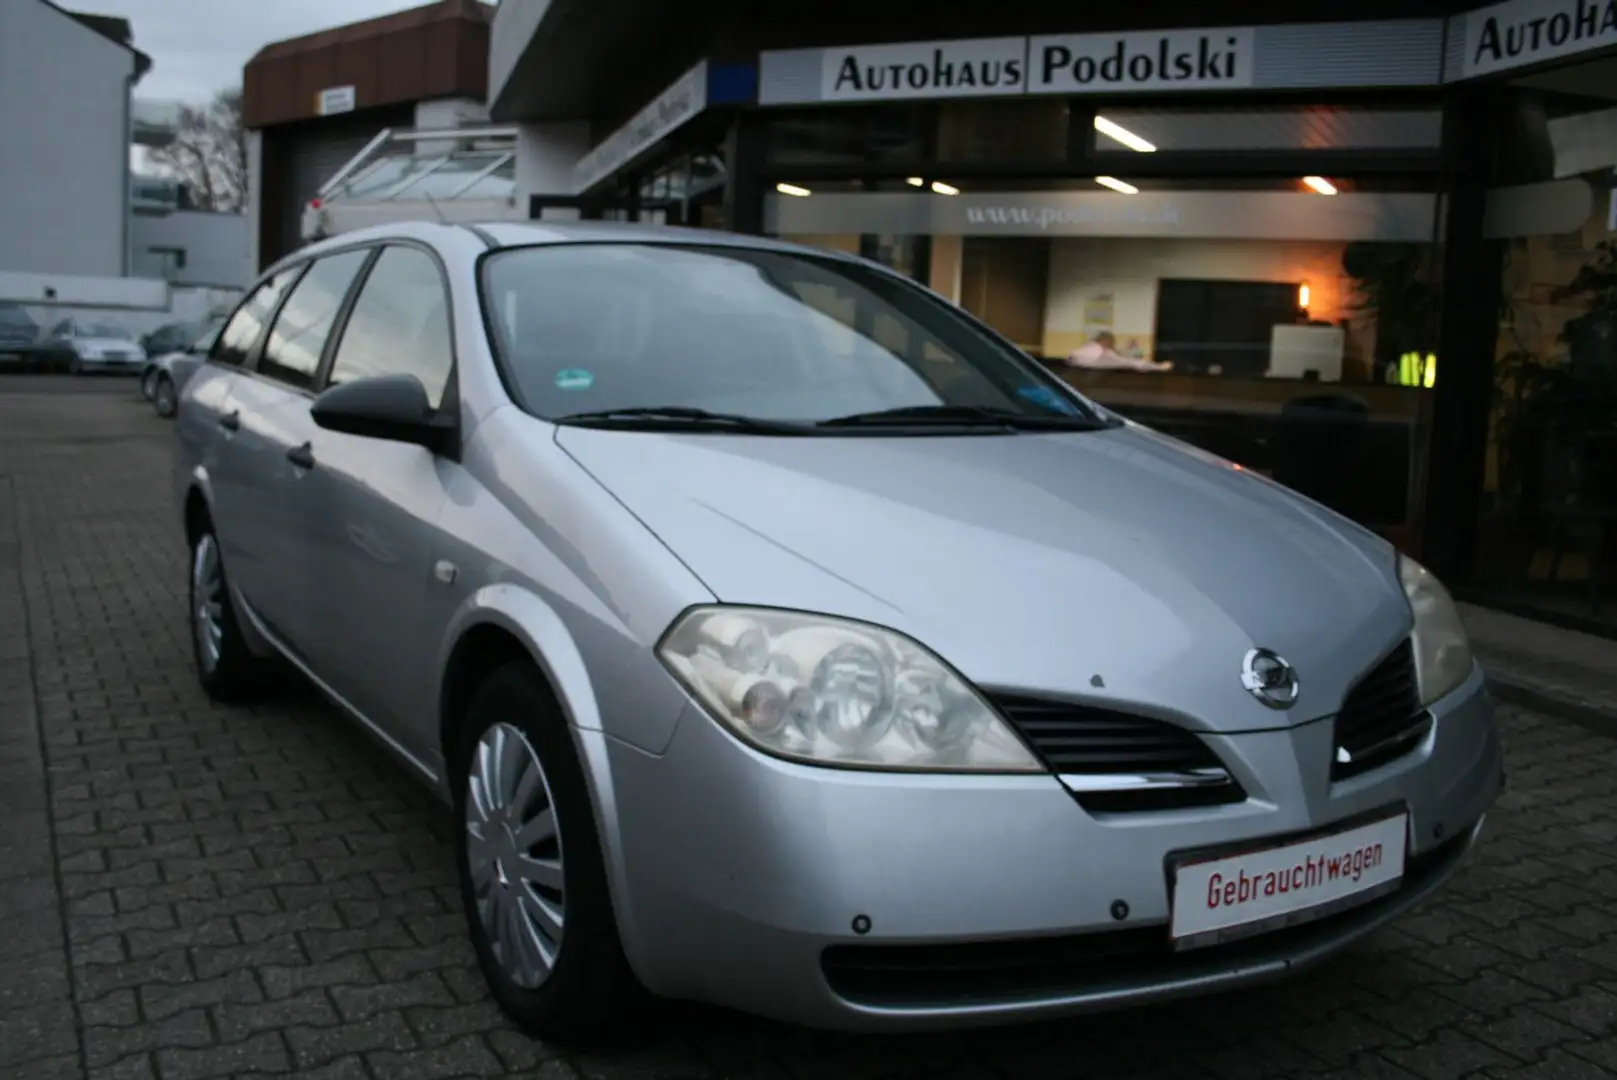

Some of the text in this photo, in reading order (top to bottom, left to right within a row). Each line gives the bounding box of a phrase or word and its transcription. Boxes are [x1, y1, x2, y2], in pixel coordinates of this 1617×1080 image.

[1042, 37, 1238, 84] Podolski
[965, 201, 1181, 229] www.podski.de
[1207, 843, 1383, 908] Gebrauchtwagen
